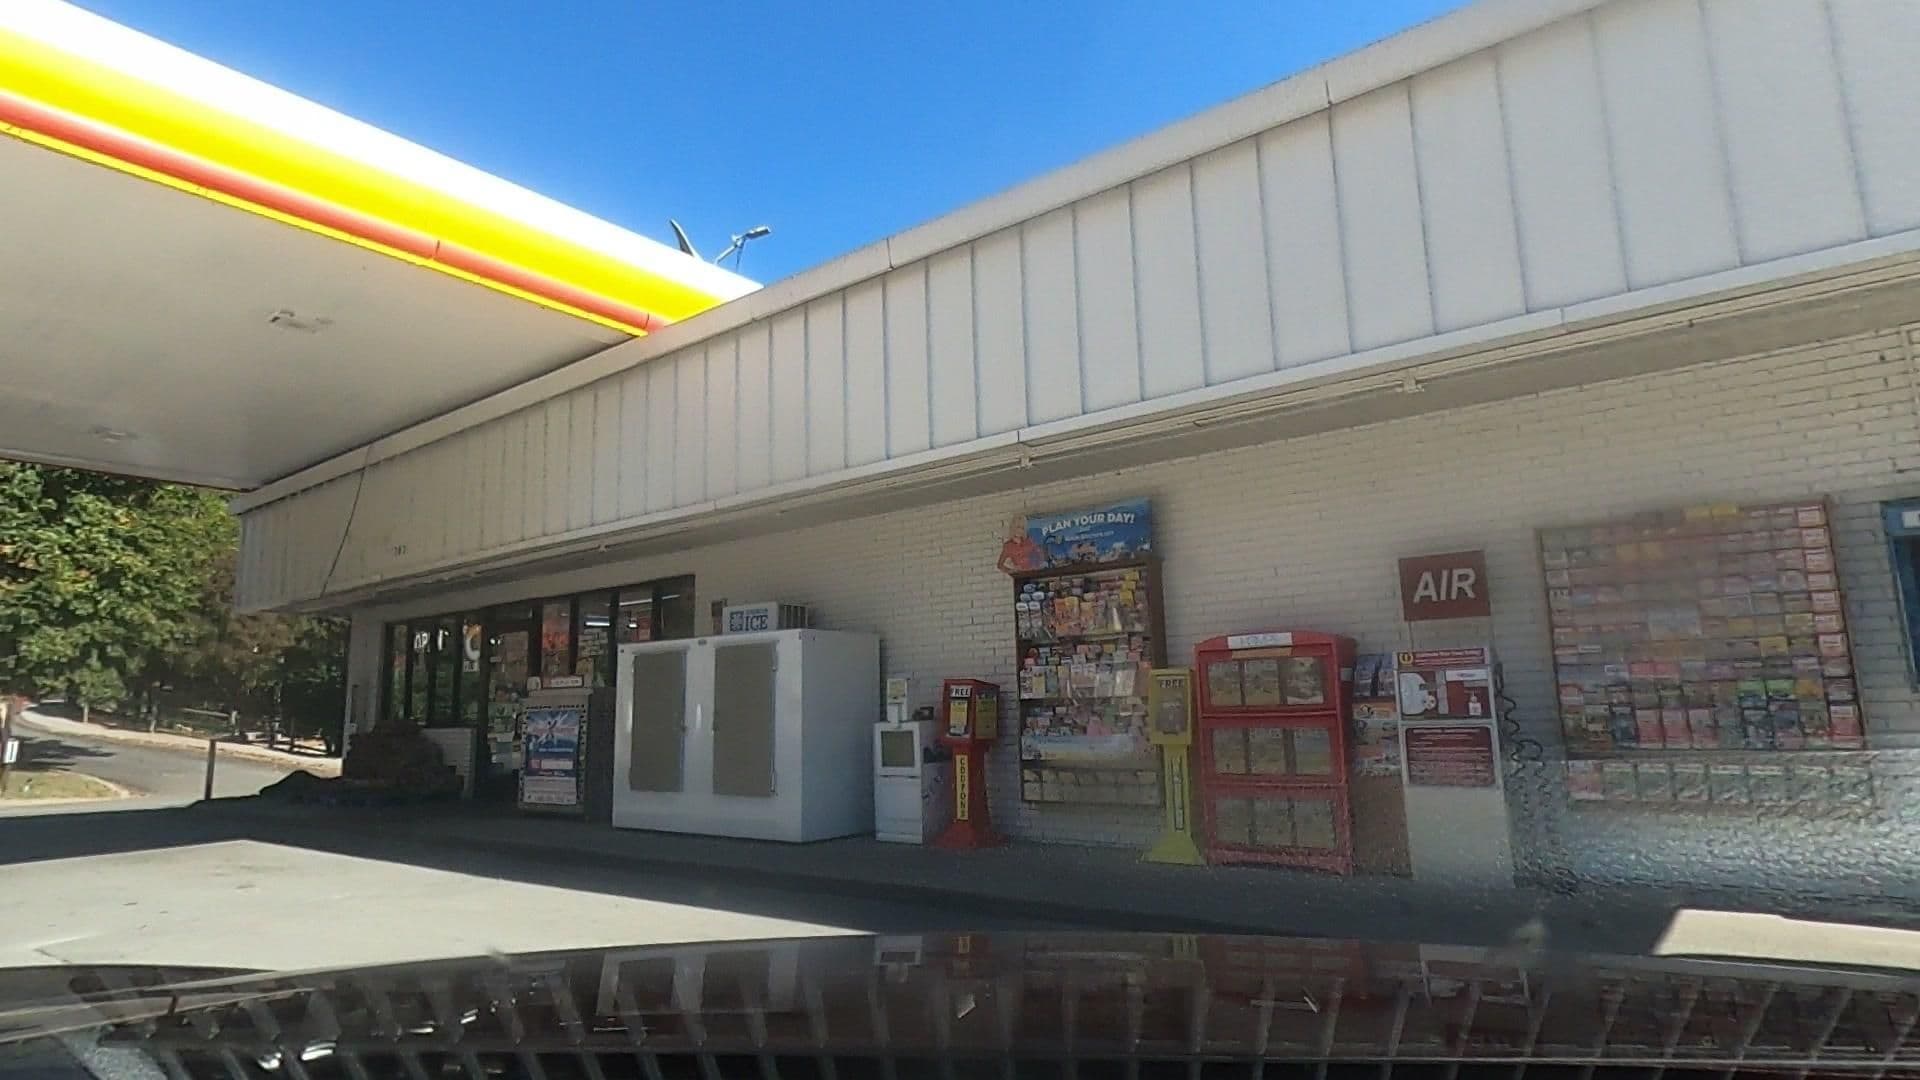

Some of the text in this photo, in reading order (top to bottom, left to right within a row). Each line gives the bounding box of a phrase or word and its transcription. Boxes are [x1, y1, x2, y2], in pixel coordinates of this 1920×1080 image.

[1041, 519, 1072, 537] PLAN
[1073, 513, 1105, 526] YOUR
[1107, 512, 1136, 524] DAY!
[1413, 567, 1476, 603] AIR
[744, 614, 769, 632] ICE
[1159, 679, 1185, 689] FREE
[959, 757, 967, 819] COUPONS
